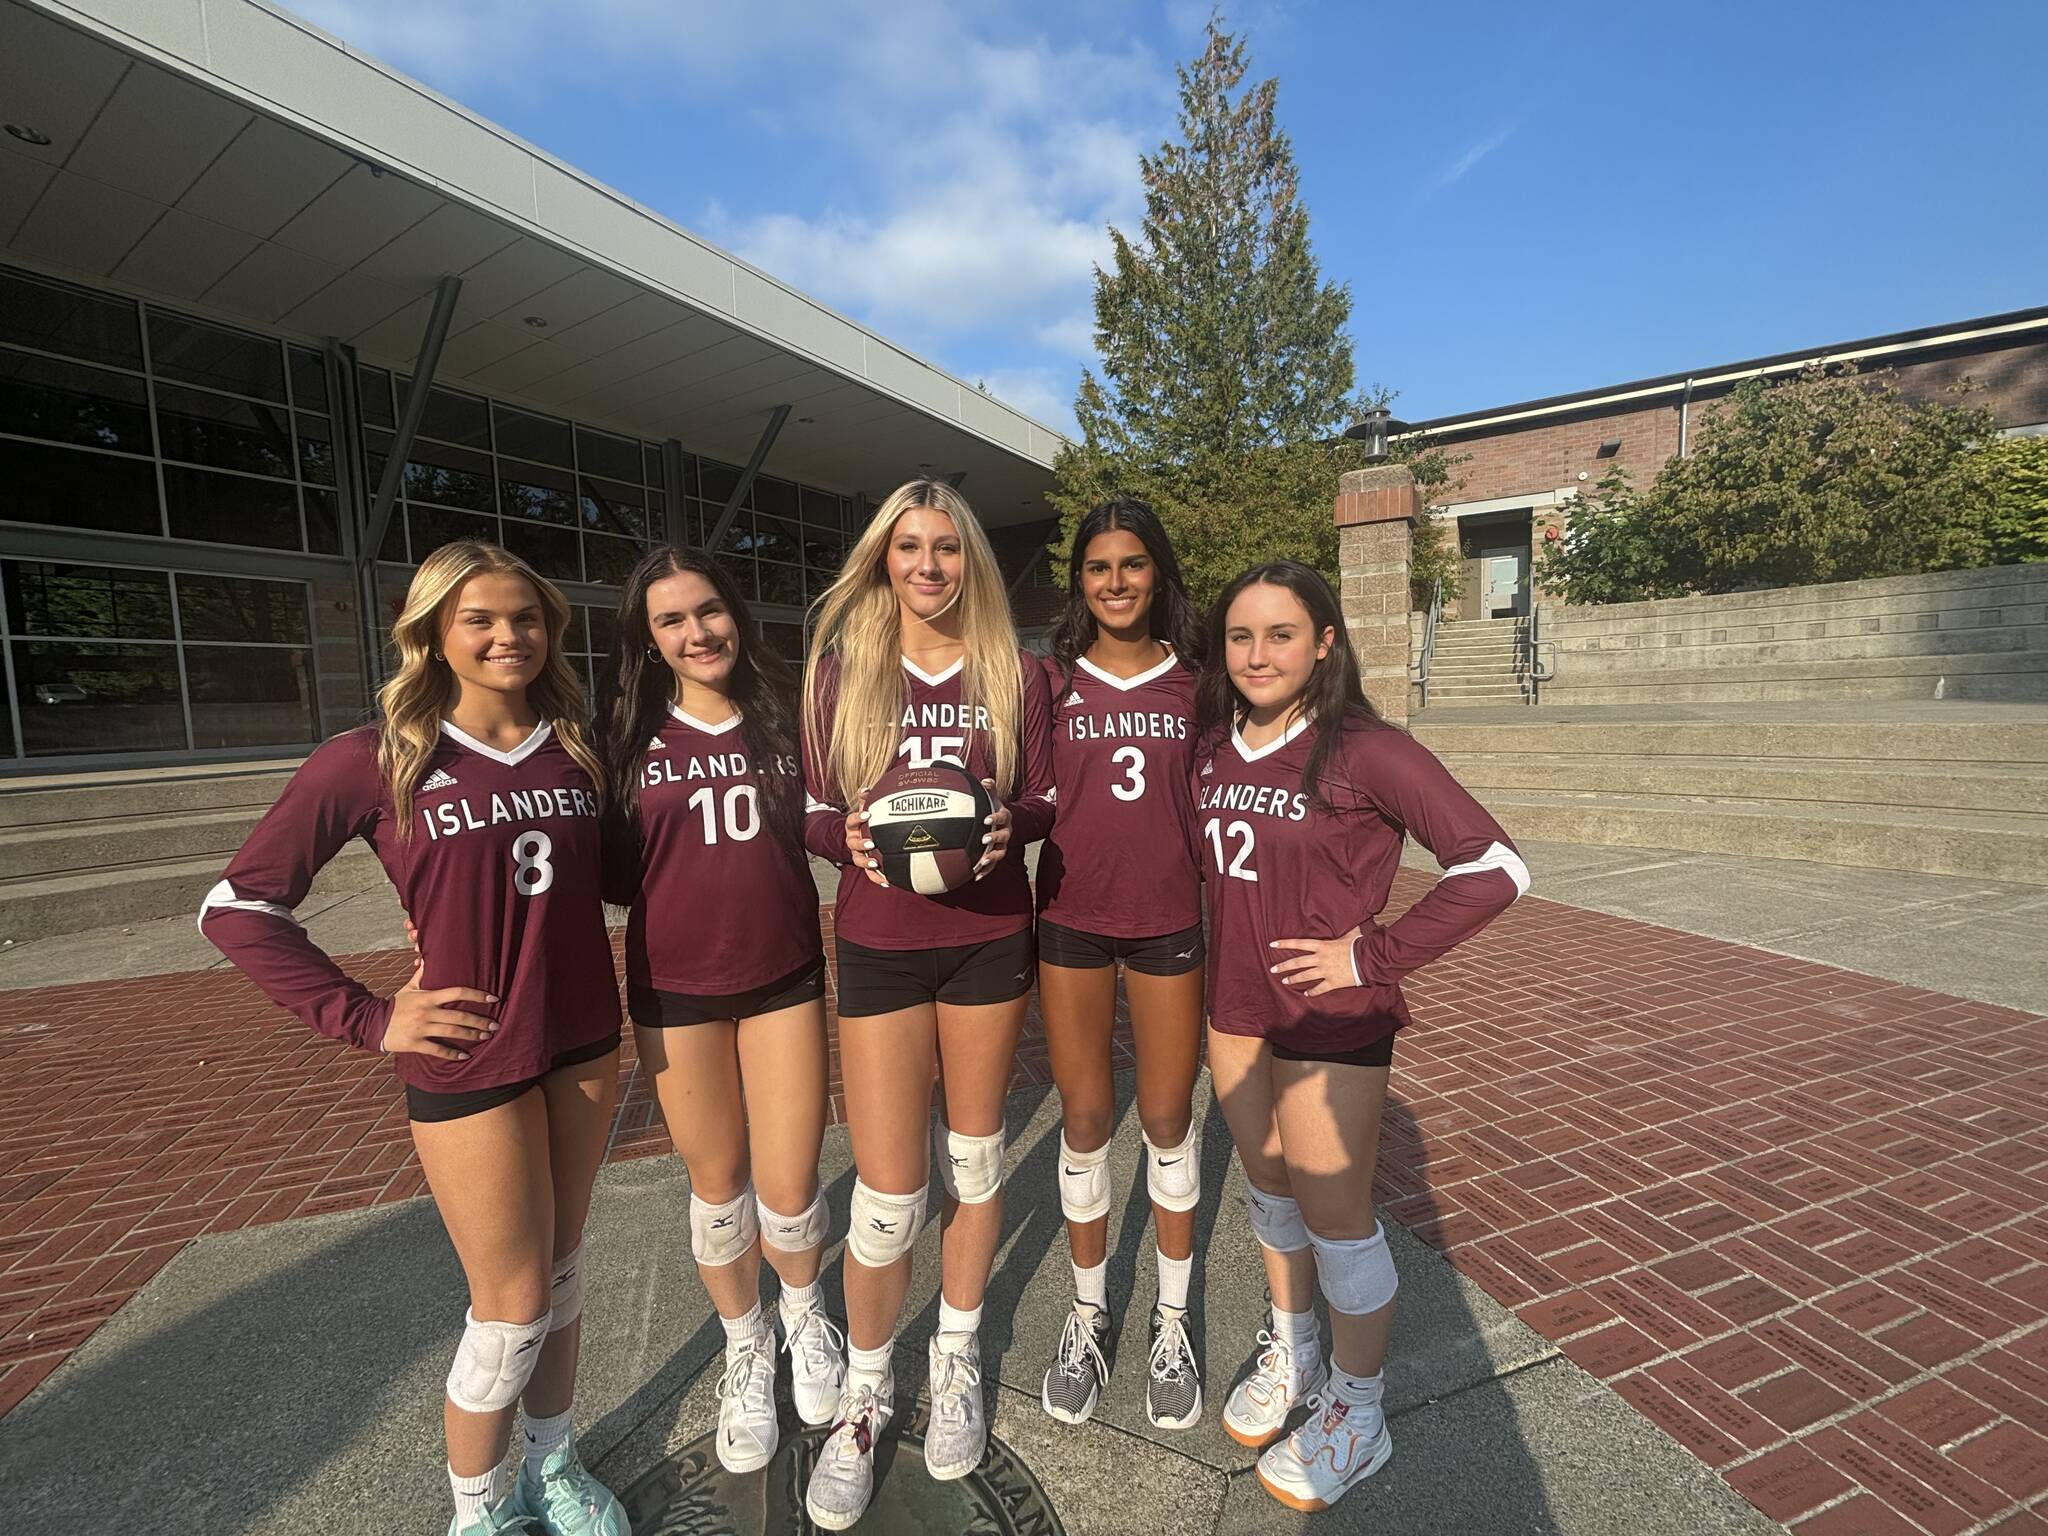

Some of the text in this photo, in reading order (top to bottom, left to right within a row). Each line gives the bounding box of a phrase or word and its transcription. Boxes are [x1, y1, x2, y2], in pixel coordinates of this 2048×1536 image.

[1068, 712, 1186, 741] ISLANDERS
[898, 735, 965, 769] 15
[1110, 745, 1146, 801] 3
[422, 777, 459, 791] adidas
[898, 770, 940, 781] OFFICIAL
[422, 788, 598, 841] ISLANDERS
[688, 784, 761, 845] 10
[888, 796, 947, 812] TACHIKARA
[511, 830, 554, 896] 8
[1204, 817, 1258, 882] 12
